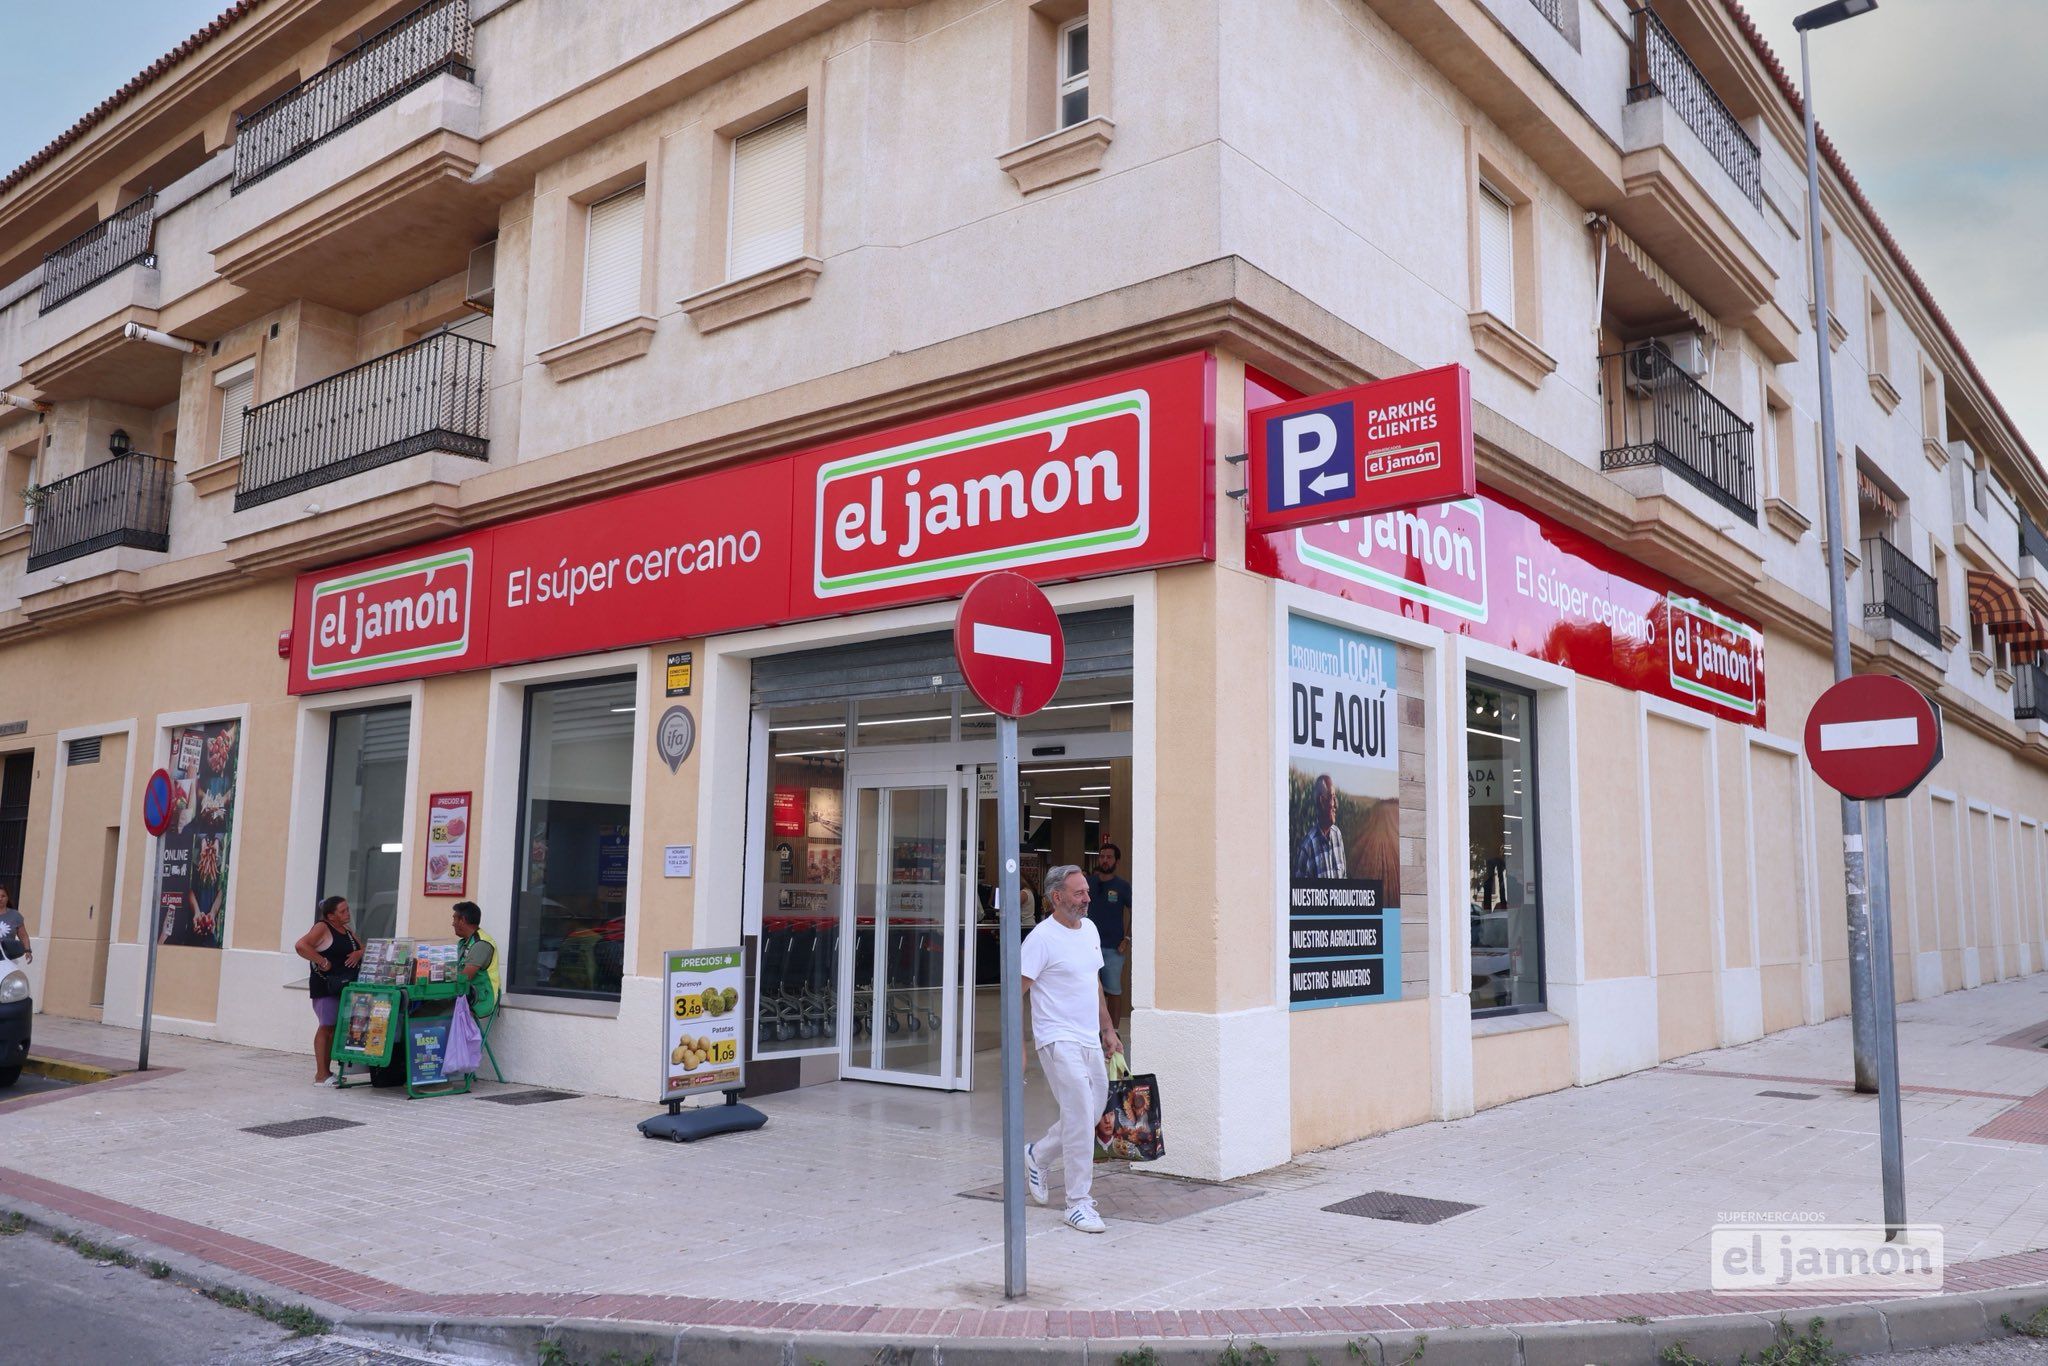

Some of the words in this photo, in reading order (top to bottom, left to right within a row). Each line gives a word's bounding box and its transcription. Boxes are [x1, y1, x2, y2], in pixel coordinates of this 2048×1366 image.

[1368, 397, 1436, 424] PARKING
[1367, 414, 1438, 440] CLIENTES
[1282, 413, 1338, 507] P
[1370, 457, 1384, 473] el
[1386, 447, 1436, 473] jamón
[835, 476, 887, 551] el
[898, 427, 1122, 557] jamón
[508, 570, 531, 607] El
[536, 558, 618, 606] súper
[625, 530, 761, 585] cercano
[320, 607, 346, 649] el
[350, 569, 458, 654] jamón
[1515, 556, 1534, 598] El
[1538, 568, 1588, 619] súper
[1592, 596, 1655, 645] cercano
[1675, 616, 1693, 665] el
[1291, 644, 1339, 677] PRODUCTO
[1339, 638, 1388, 686] LOCAL
[1292, 682, 1325, 748] DE
[1333, 689, 1387, 758] AQUÍ
[666, 730, 683, 749] ifa
[164, 849, 189, 861] ONLINE
[1292, 888, 1329, 906] NUESTROS
[1329, 889, 1375, 907] PRODUCTORES
[1292, 930, 1329, 948] NUESTROS
[1330, 929, 1377, 947] AGRICULTORES
[681, 956, 723, 967] ¡PRECIOS!
[676, 981, 702, 989] Chirimoya
[1293, 971, 1329, 991] NUESTROS
[1331, 968, 1371, 988] GANADEROS
